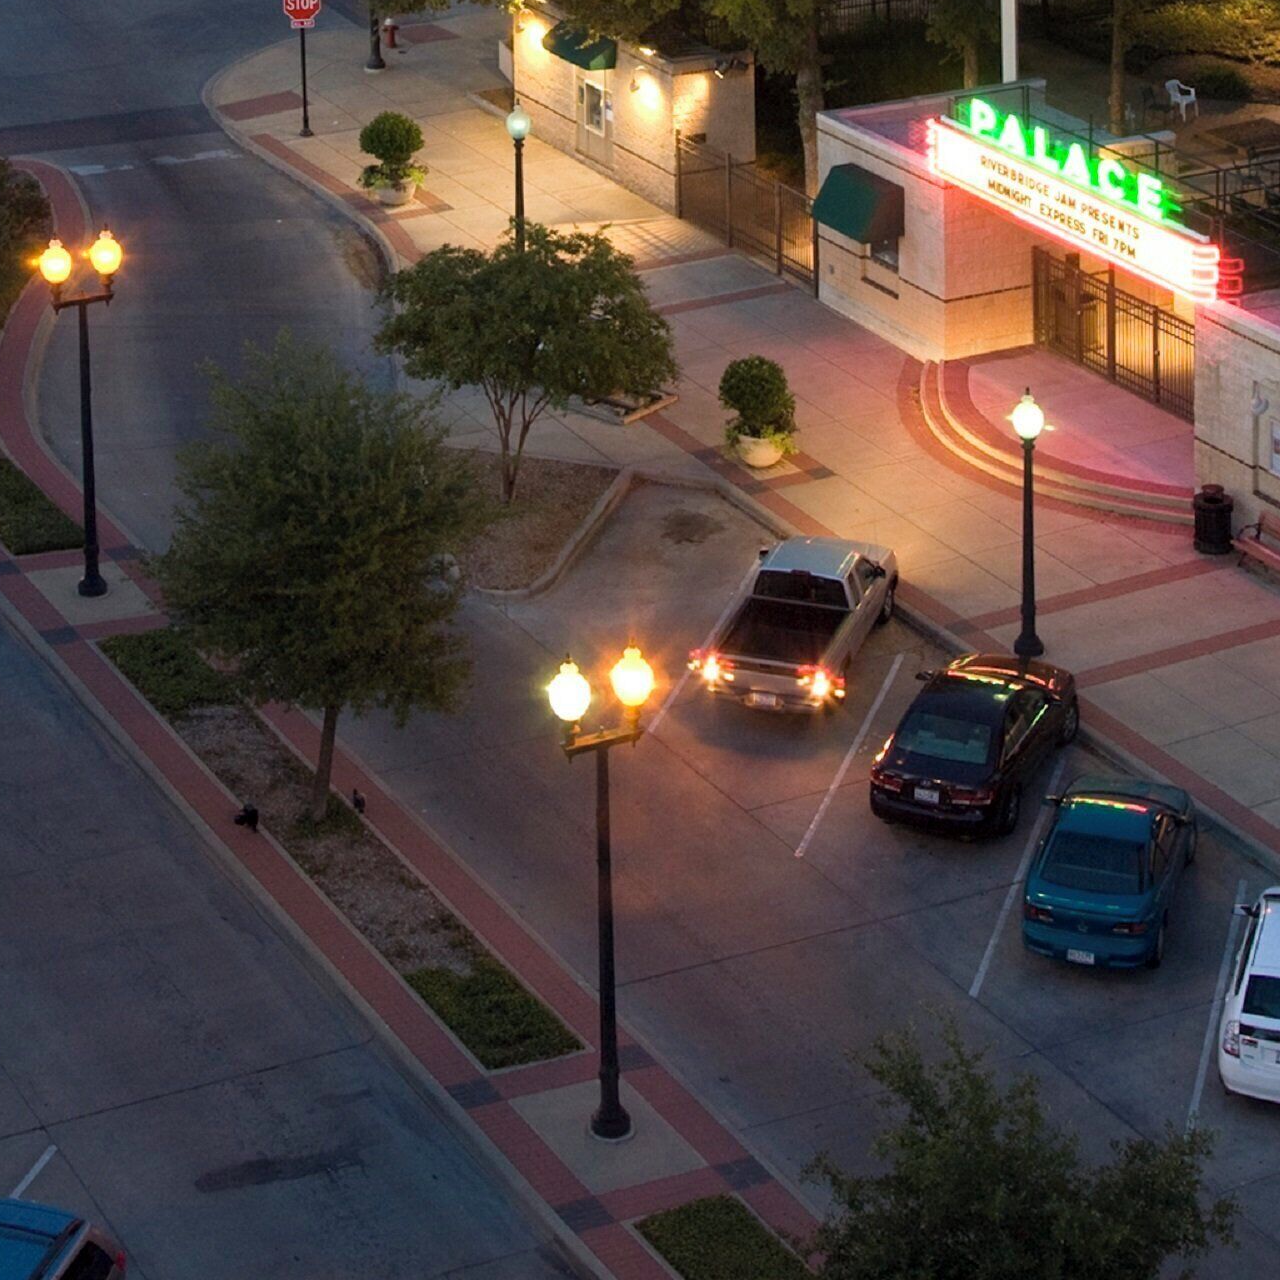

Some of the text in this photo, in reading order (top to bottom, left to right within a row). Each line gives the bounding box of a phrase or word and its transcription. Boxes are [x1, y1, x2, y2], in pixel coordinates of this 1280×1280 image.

[969, 98, 1164, 220] PALACE
[980, 155, 1140, 240] RIVERBRIDGE JAM PRESENTS
[988, 178, 1136, 260] MIDNIGHT EXPRESS FRI 7PM
